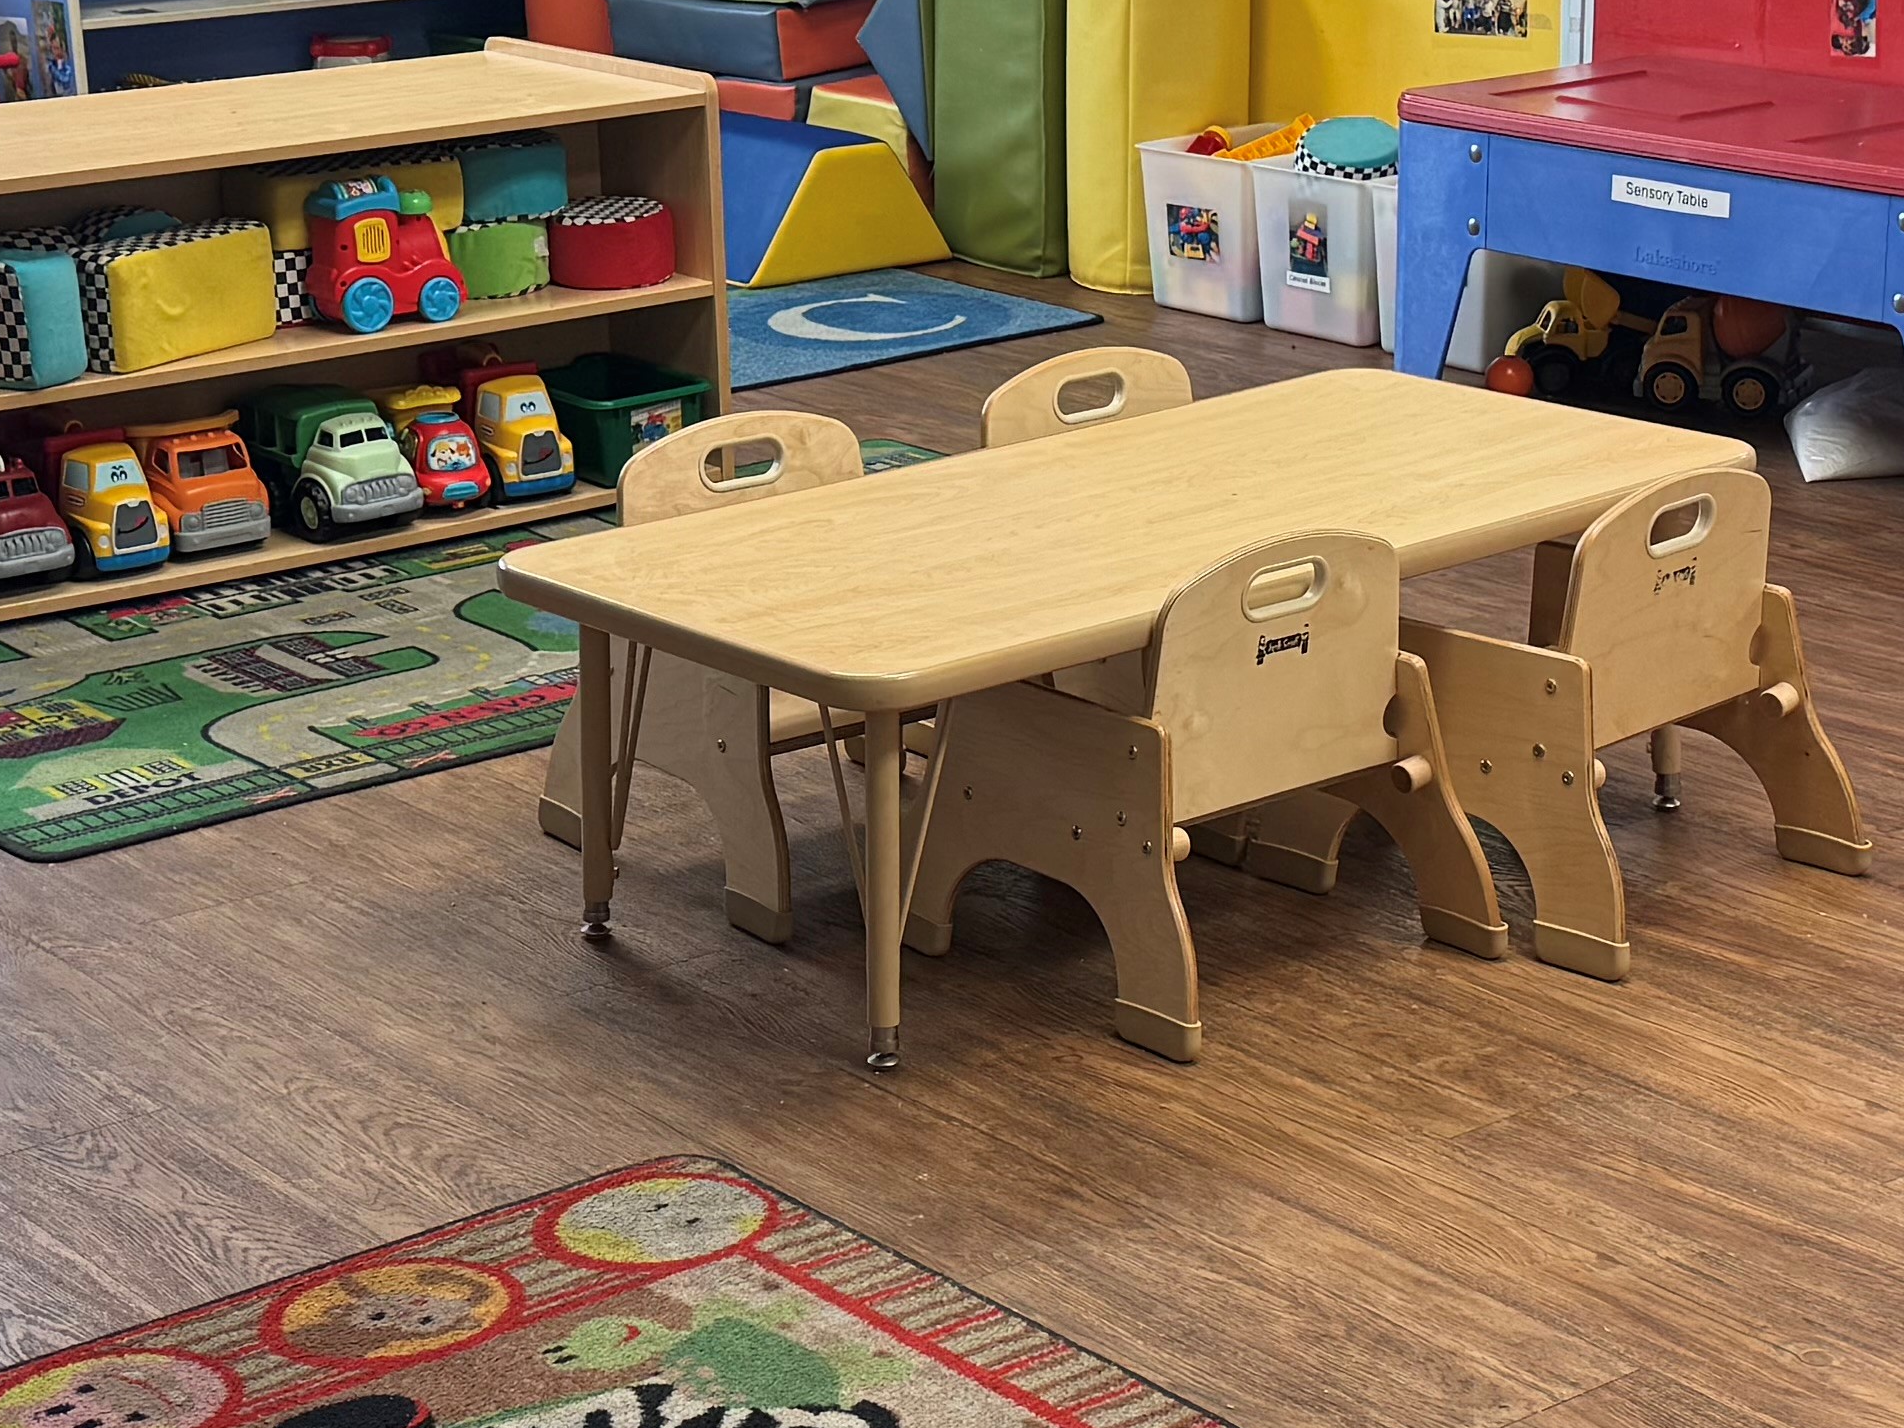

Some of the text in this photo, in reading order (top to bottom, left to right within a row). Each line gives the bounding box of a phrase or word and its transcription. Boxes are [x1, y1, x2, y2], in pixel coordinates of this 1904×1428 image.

[1625, 181, 1709, 208] Sensory Table
[85, 773, 202, 807] DEPOT
